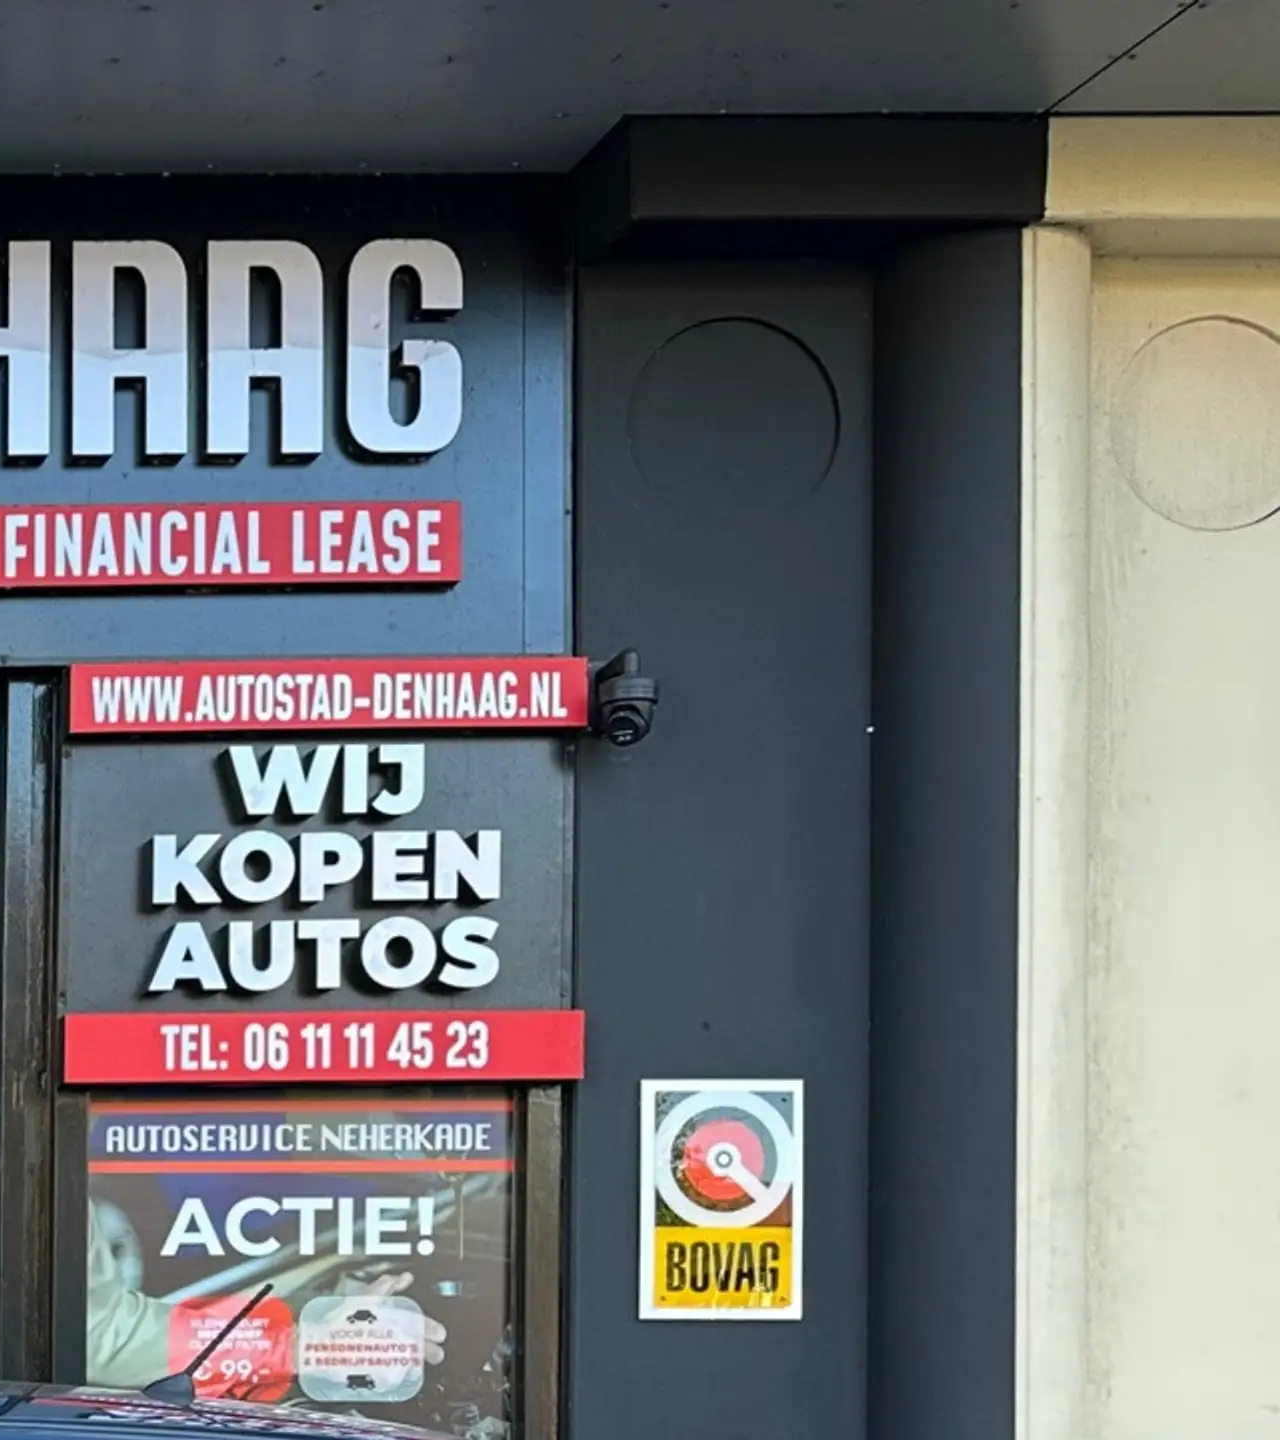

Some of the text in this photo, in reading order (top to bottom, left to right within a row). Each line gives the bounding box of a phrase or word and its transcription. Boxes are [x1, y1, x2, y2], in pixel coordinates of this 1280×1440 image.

[4, 508, 441, 578] FINANCIAL LEASE
[92, 671, 568, 724] WWW.AUTOSTAD-DENHAAG.NL
[229, 743, 426, 816] WIJ
[152, 830, 502, 905] KOPEN
[148, 916, 500, 992] AUTOS
[161, 1021, 489, 1070] TEL: 06 11 11 45 23
[106, 1122, 491, 1153] AUTOSERVICE NEHERKADE
[160, 1196, 436, 1258] ACTIE!
[666, 1242, 779, 1293] BOVAG
[220, 1359, 272, 1384] 99,-
